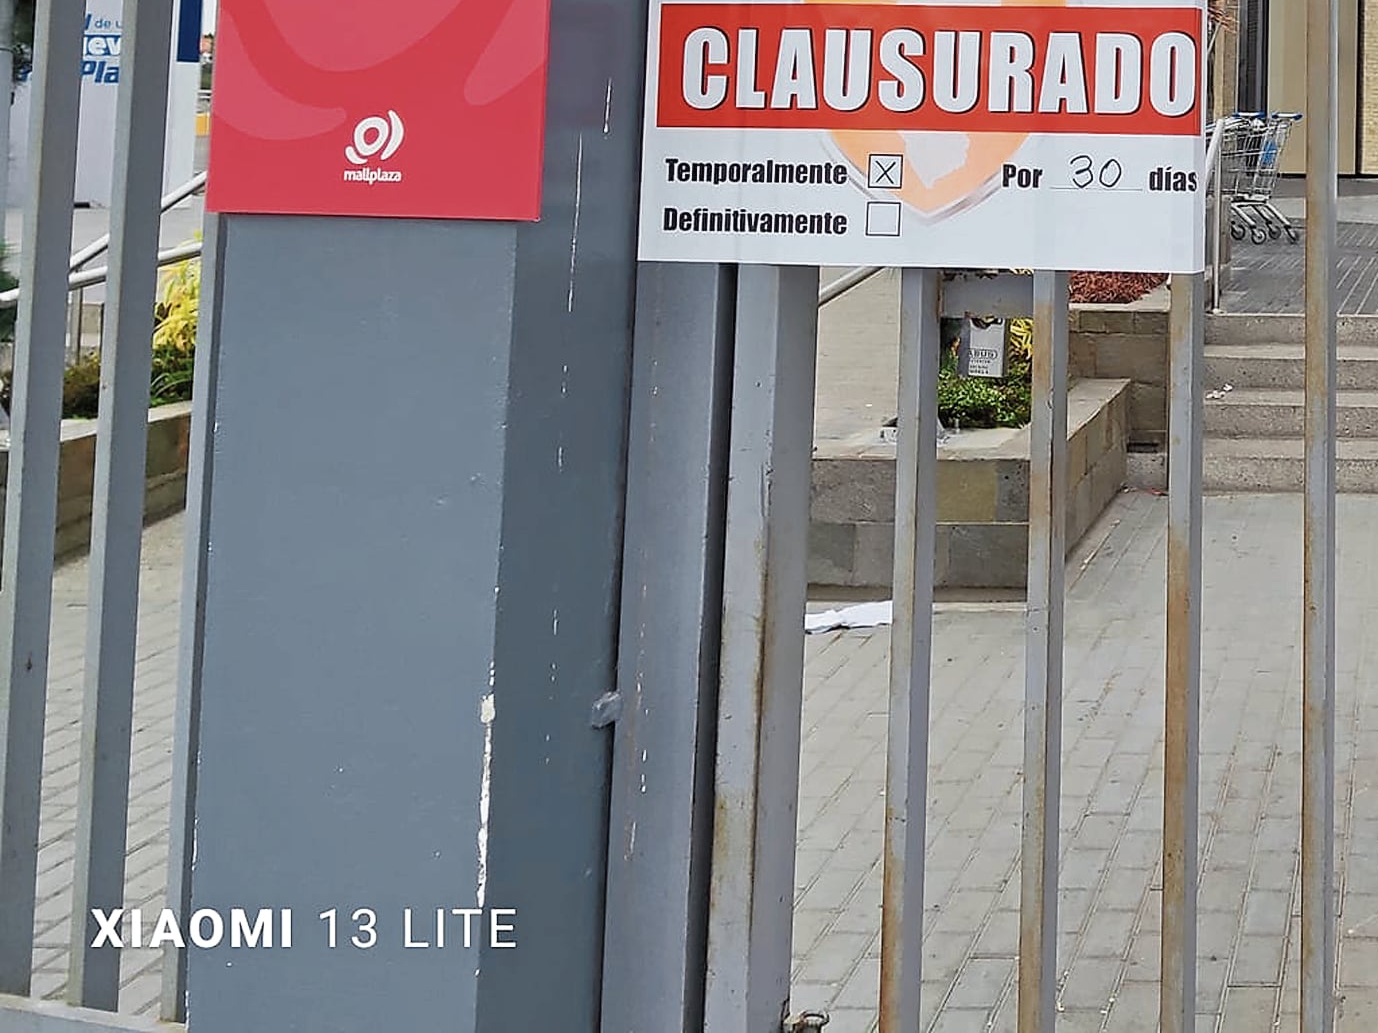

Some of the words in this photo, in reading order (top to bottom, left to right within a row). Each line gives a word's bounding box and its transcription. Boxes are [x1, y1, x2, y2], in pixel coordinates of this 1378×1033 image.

[682, 26, 1198, 117] CLAUSURADO
[343, 167, 402, 185] mallplaza
[666, 158, 848, 185] Temporalmente
[1002, 164, 1043, 189] Por
[1070, 155, 1122, 188] 30
[1149, 166, 1198, 192] días
[663, 207, 848, 235] Definitivamente
